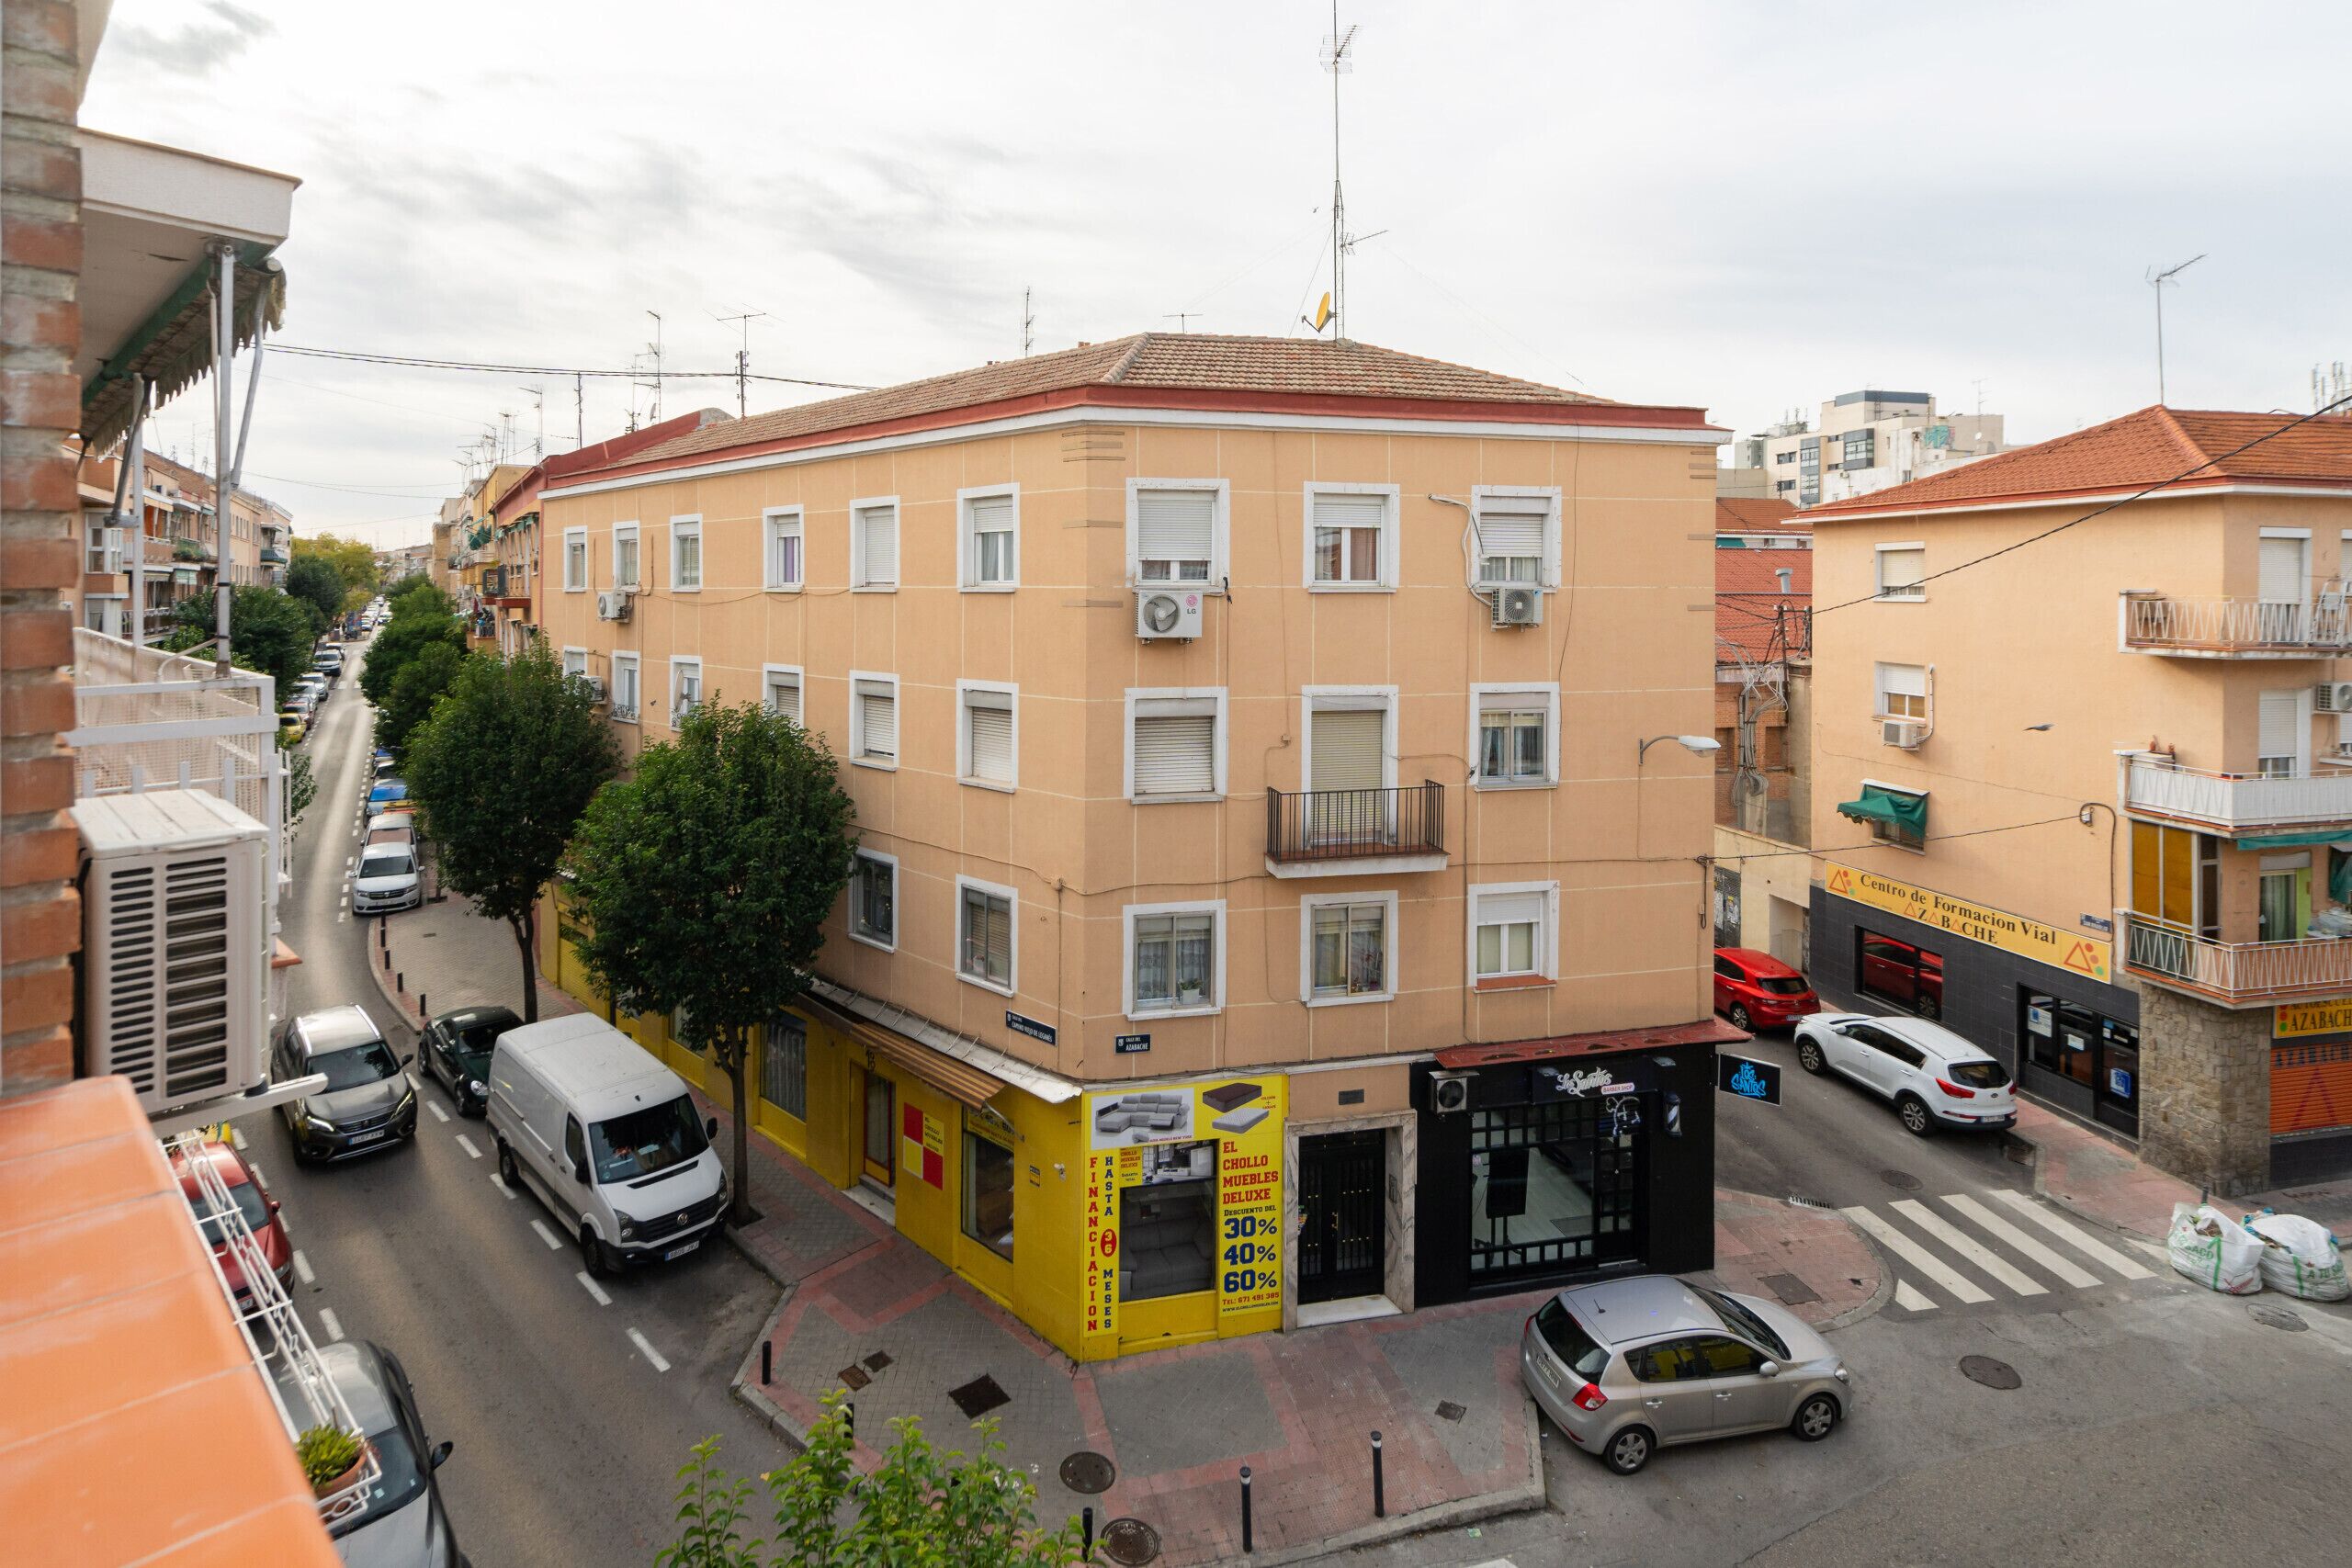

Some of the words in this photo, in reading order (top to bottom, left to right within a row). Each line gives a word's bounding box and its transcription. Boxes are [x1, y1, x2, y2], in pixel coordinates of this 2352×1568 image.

[1860, 874, 1906, 898] Centro
[1911, 889, 1927, 905] de
[1933, 896, 2017, 933] Formacion
[2020, 920, 2056, 945] Vial
[1125, 1043, 1148, 1052] AZABACHE
[1567, 1066, 1612, 1097] Santos
[1223, 1141, 1238, 1154] EL
[1223, 1155, 1269, 1171] CHOLLO
[1104, 1156, 1114, 1216] HASTA
[1223, 1170, 1279, 1188] MUEBLES
[1223, 1188, 1272, 1205] DELUXE
[1224, 1215, 1277, 1239] 30%
[1087, 1156, 1099, 1331] FINANCIACION
[1224, 1242, 1276, 1266] 40%
[1224, 1269, 1277, 1293] 60%
[1103, 1268, 1114, 1328] MESES
